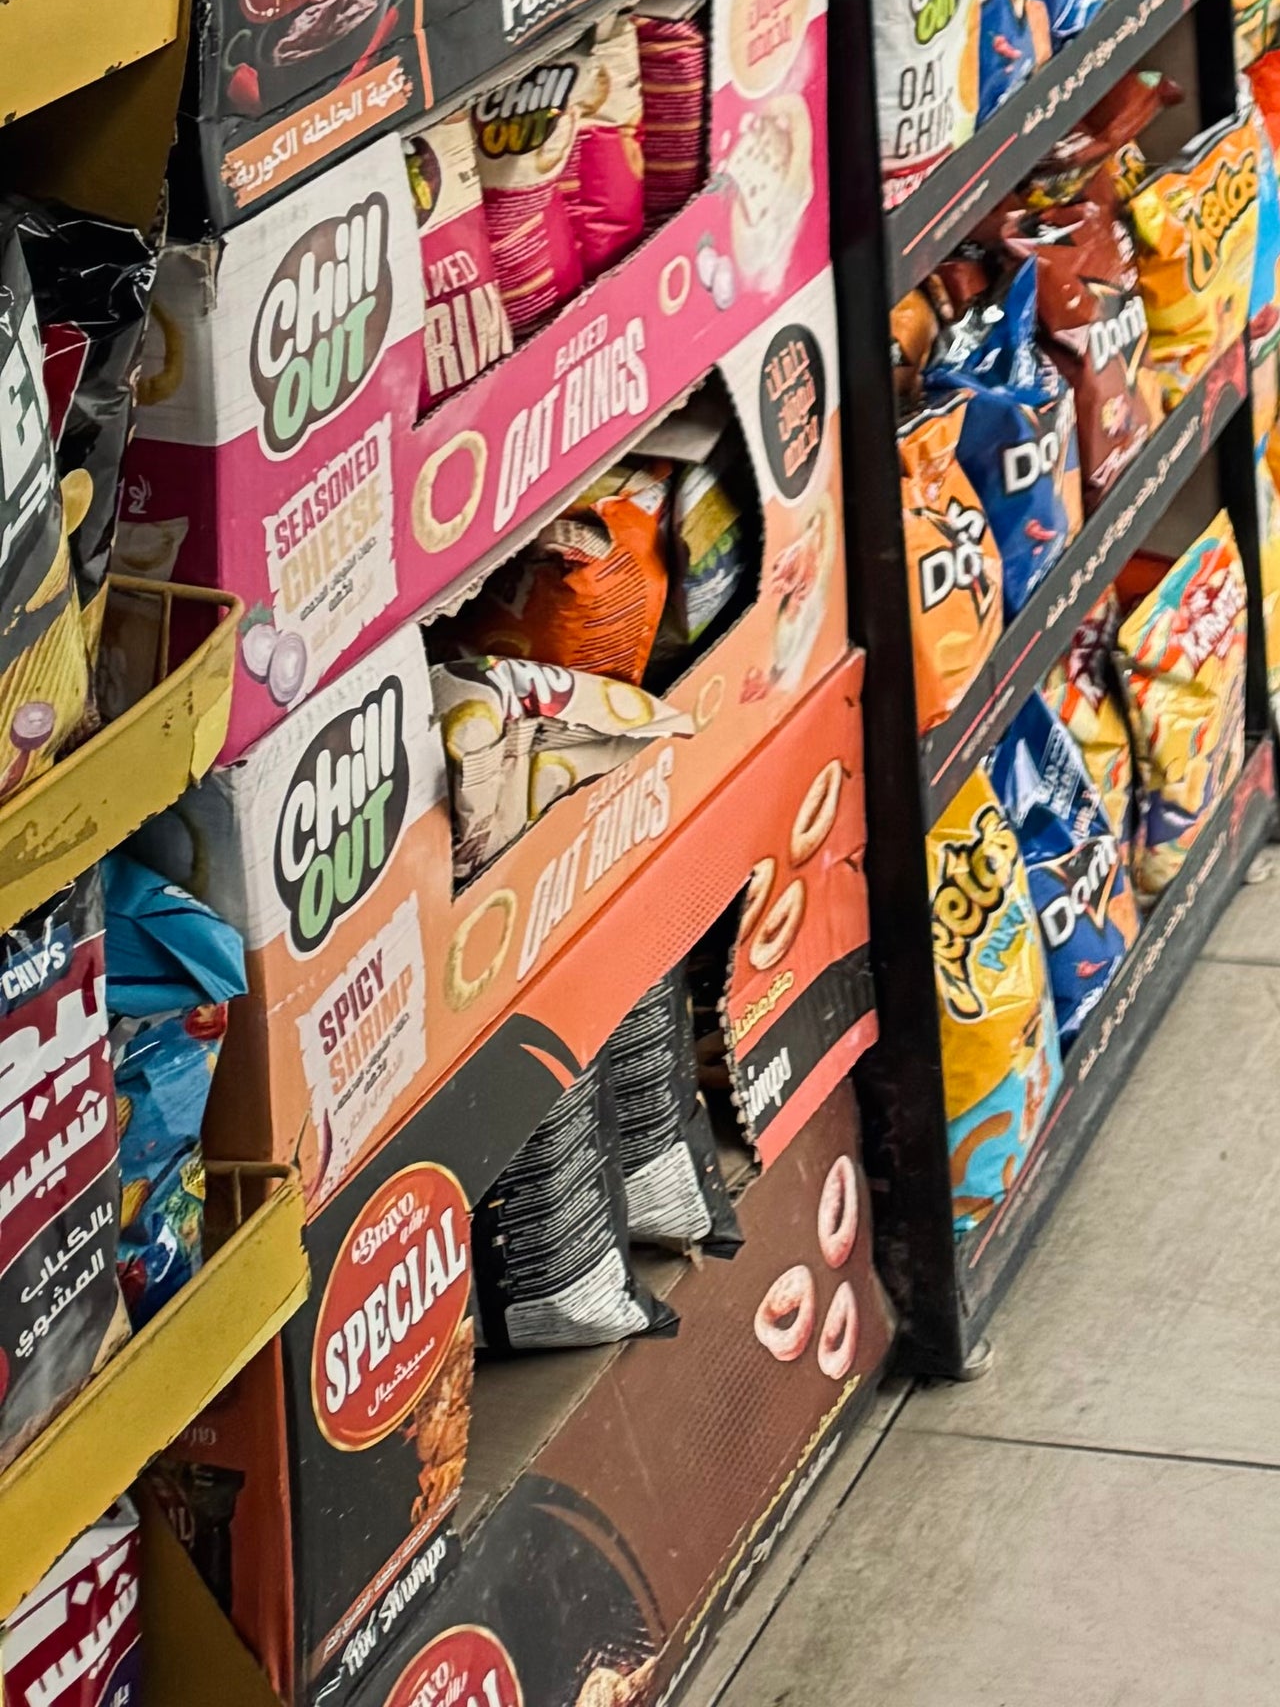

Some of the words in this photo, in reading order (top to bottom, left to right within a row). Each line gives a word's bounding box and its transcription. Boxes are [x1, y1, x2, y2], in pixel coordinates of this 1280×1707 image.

[302, 88, 363, 146] الخلطة
[366, 66, 405, 108] نكهة
[482, 108, 557, 151] OUT
[234, 128, 298, 190] الكورية
[272, 301, 369, 439] OUT
[553, 313, 609, 380] BAKED
[493, 384, 559, 533] OAT
[561, 317, 649, 456] RINGS
[274, 434, 381, 561] SEASONED
[280, 481, 383, 614] CHEESE
[298, 799, 394, 941] OUT
[517, 827, 588, 983] OAT
[583, 745, 675, 894] RINGS
[318, 948, 386, 1056] SPICY
[328, 964, 413, 1097] SHRIMP
[20, 1201, 114, 1304] بالكباب
[351, 1191, 415, 1265] Bravo
[15, 1248, 106, 1359] المشوي
[325, 1206, 467, 1414] SPECIAL
[367, 1337, 435, 1418] سبيشيال
